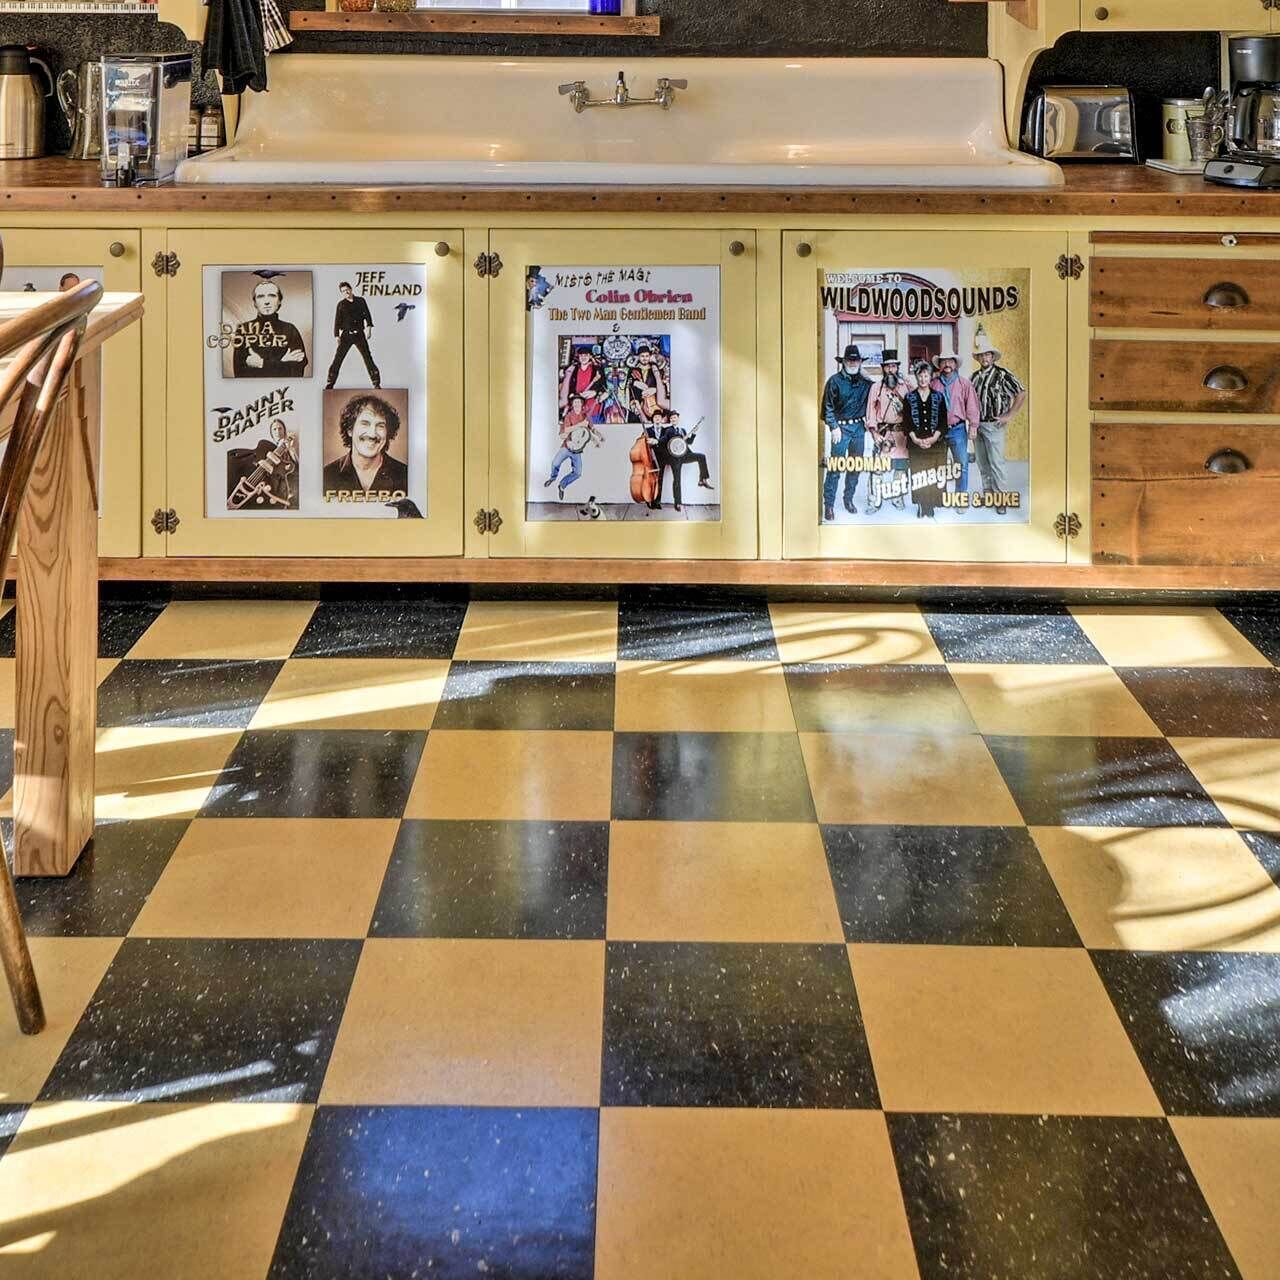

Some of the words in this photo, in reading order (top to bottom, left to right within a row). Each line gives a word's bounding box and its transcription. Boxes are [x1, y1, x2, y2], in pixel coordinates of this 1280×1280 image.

[355, 272, 386, 287] JEFF
[886, 274, 903, 284] TO
[361, 284, 422, 297] FINLAND
[585, 289, 631, 303] Colin
[820, 286, 1019, 318] WILDWOODSOUNDS
[548, 307, 568, 320] The
[570, 307, 591, 321] Two
[677, 307, 706, 320] Band
[207, 334, 288, 348] COOPER
[218, 387, 290, 429] DANNY
[213, 399, 294, 444] SHAFER
[826, 456, 892, 472] WOODMAN
[873, 474, 909, 506] just
[910, 461, 962, 491] magic
[325, 490, 407, 504] FREEBO
[942, 492, 969, 508] UKE
[972, 492, 984, 508] &
[984, 492, 1020, 508] DUKE
